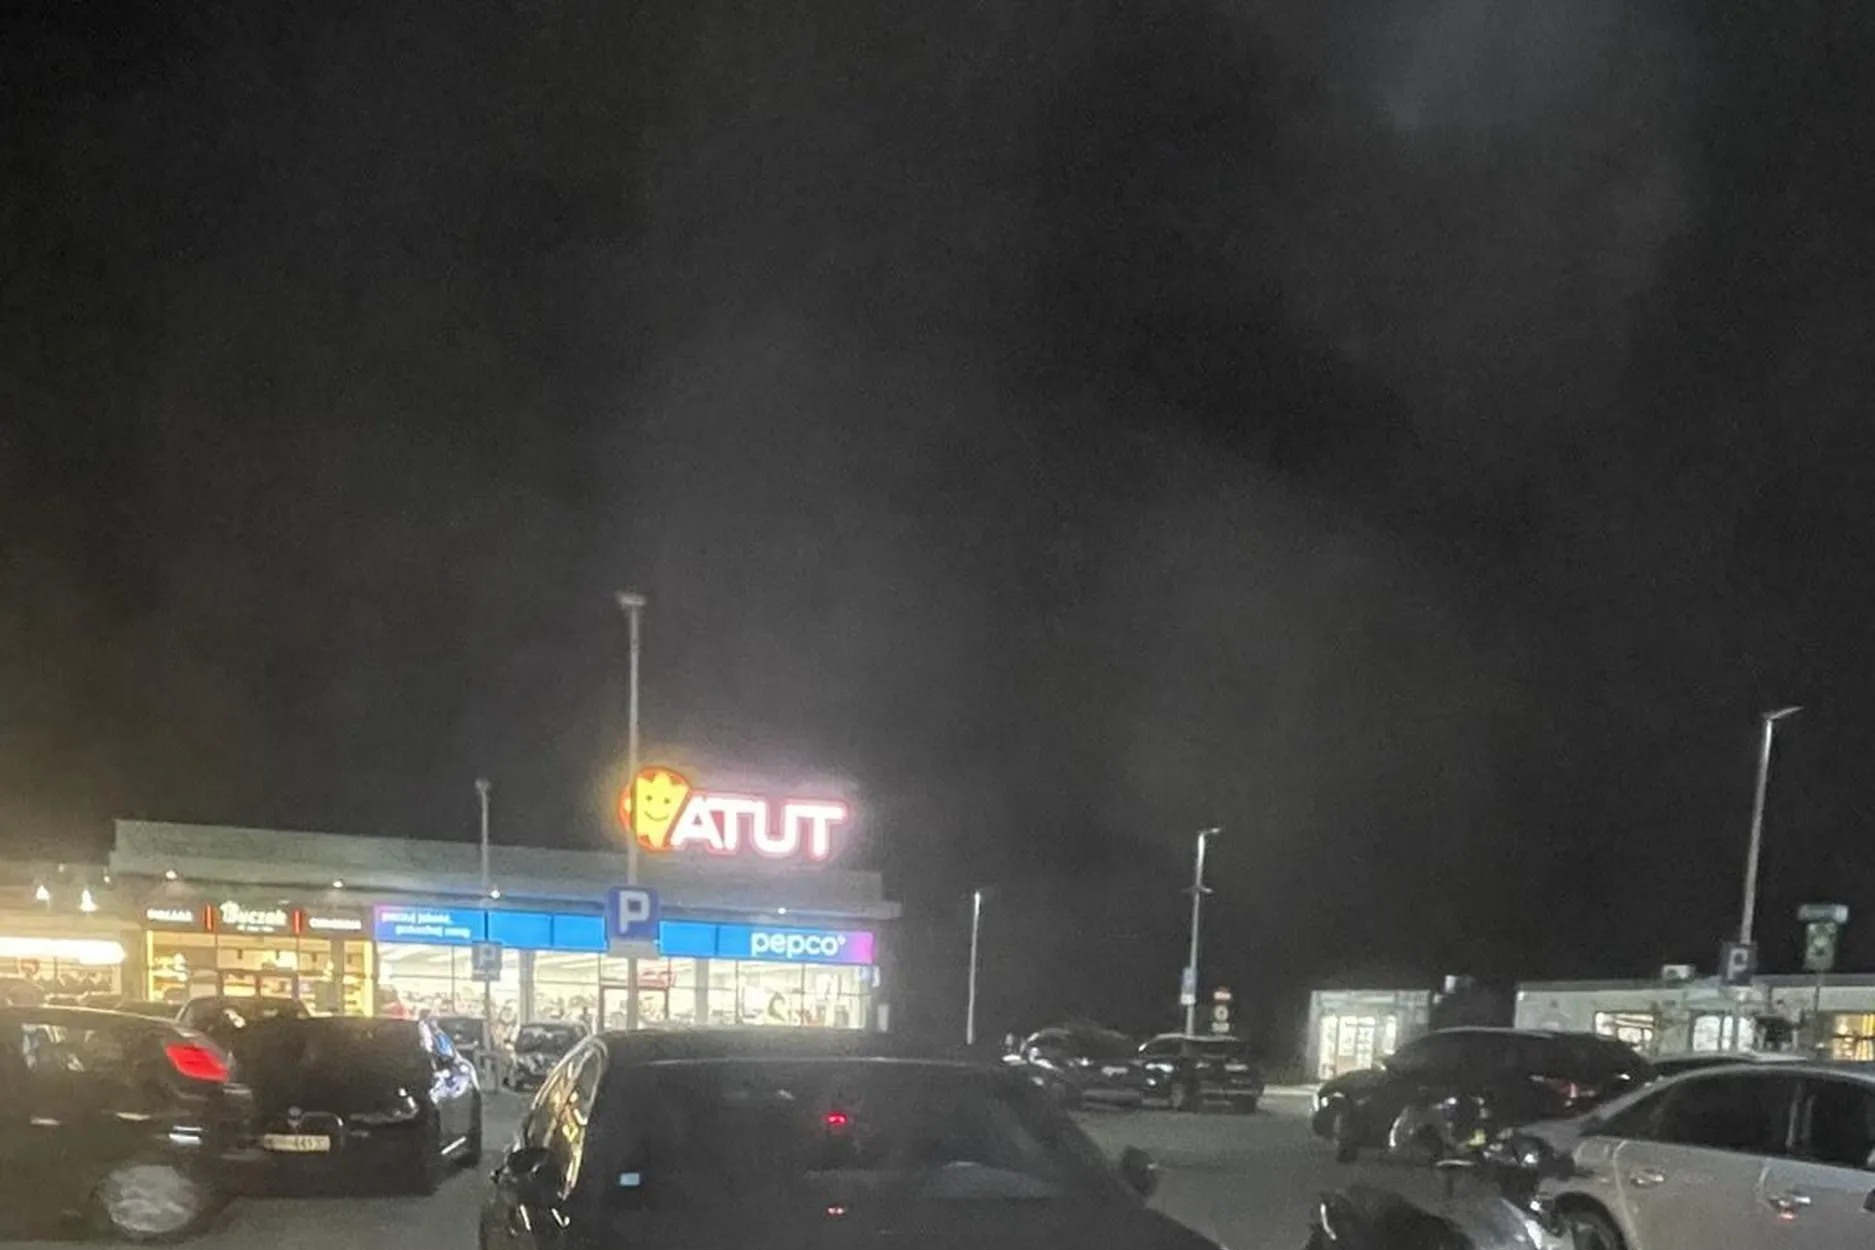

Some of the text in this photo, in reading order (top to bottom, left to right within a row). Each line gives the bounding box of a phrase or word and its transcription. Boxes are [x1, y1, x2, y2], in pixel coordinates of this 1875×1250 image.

[669, 794, 848, 860] ATUT
[618, 890, 651, 934] P
[751, 931, 838, 959] pepco
[1727, 948, 1749, 981] P
